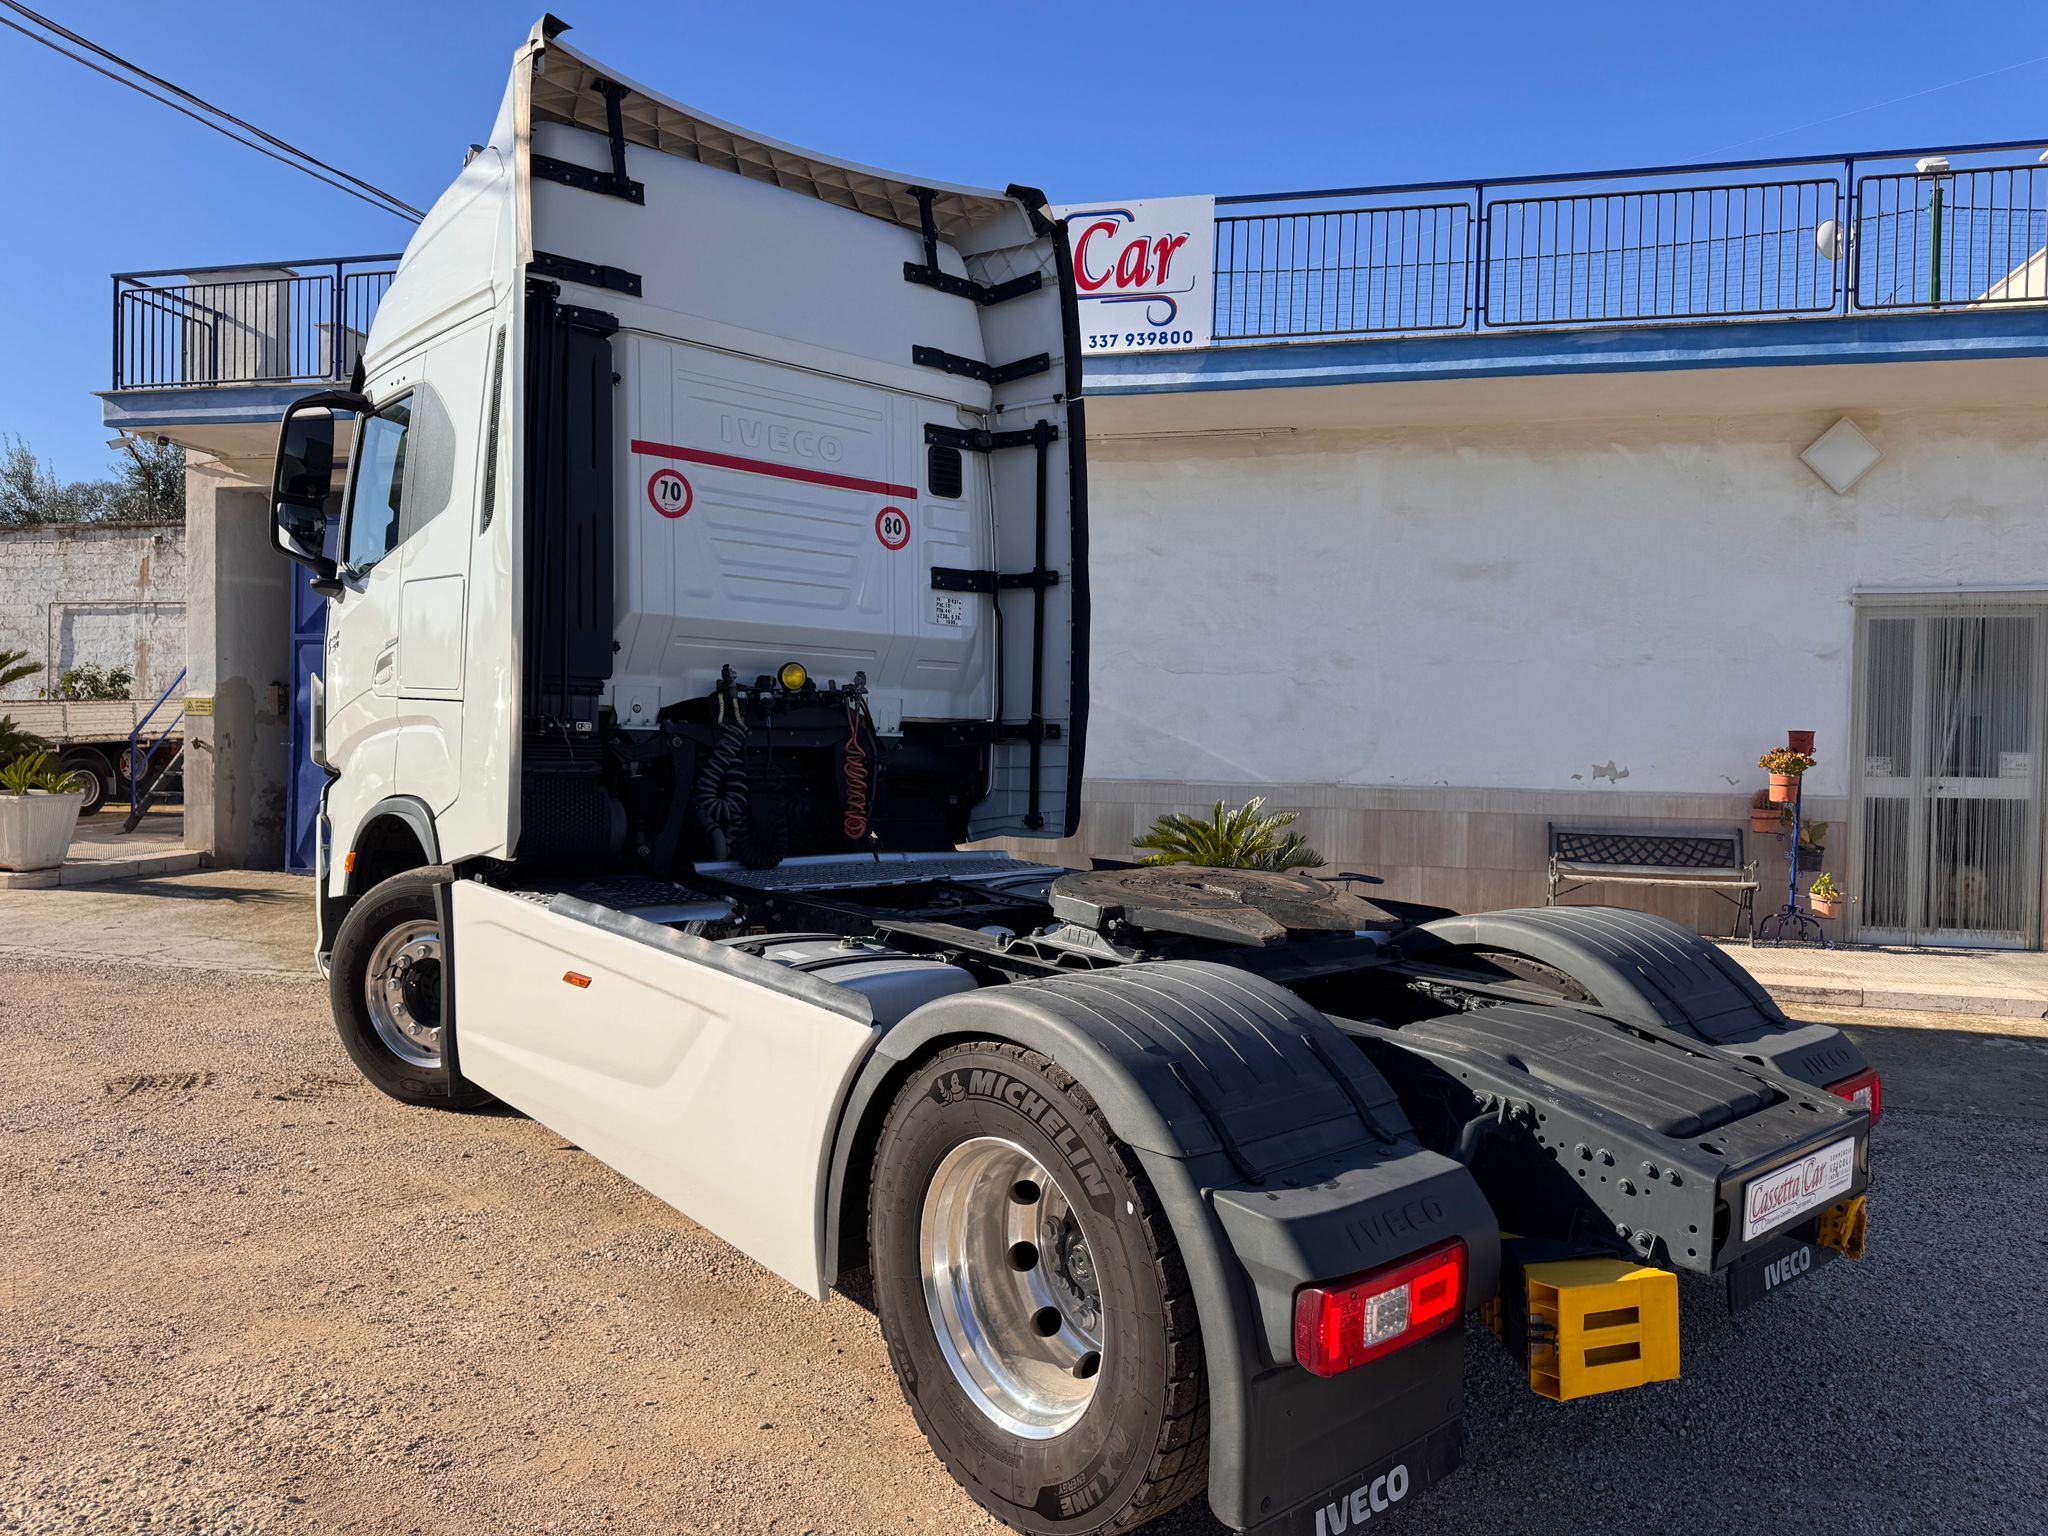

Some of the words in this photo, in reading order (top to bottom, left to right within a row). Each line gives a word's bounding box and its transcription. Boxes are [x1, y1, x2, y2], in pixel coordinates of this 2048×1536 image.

[1073, 219, 1190, 291] Car
[1089, 334, 1118, 349] 337
[1125, 330, 1193, 347] 939800
[720, 414, 843, 462] IVECO
[660, 480, 682, 501] 70
[884, 516, 902, 535] 80
[969, 1070, 1111, 1197] MICHELIN
[1752, 1176, 1800, 1218] Cassetta
[1804, 1159, 1827, 1192] Car
[1345, 1196, 1442, 1252] IVECO
[1764, 1246, 1811, 1290] IVECO
[1058, 1472, 1086, 1495] ENERGY
[1060, 1478, 1104, 1517] LINE
[1315, 1464, 1409, 1536] IVECO
